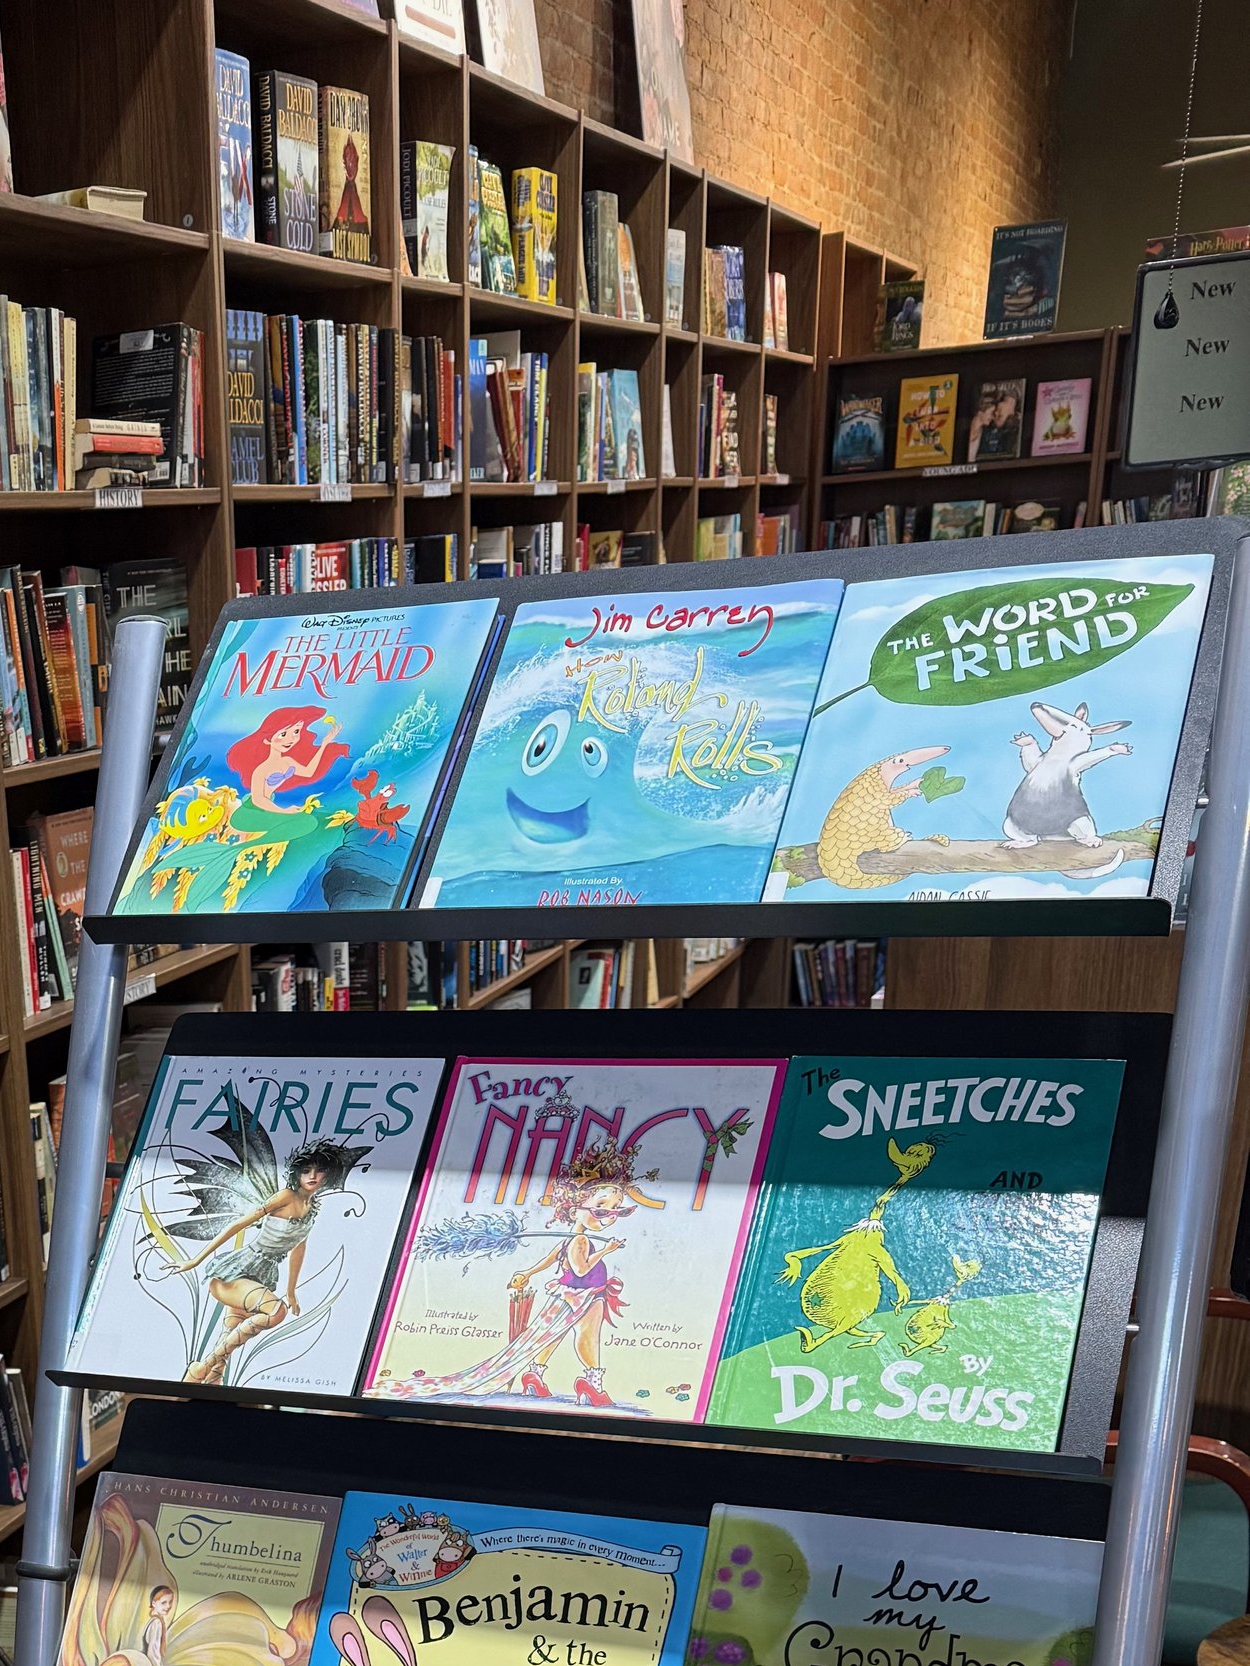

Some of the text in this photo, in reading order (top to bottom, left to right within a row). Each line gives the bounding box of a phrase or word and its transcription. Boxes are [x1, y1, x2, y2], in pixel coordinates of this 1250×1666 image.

[286, 84, 313, 113] DAVID
[284, 188, 316, 221] STONE
[288, 221, 313, 250] COLD
[1029, 224, 1063, 236] HOARDING
[1191, 280, 1236, 299] New
[1022, 317, 1052, 330] BOOKS
[1185, 339, 1229, 356] New
[1181, 395, 1225, 412] New
[99, 491, 138, 506] HISTORY
[565, 603, 774, 657] Jim Carrey
[888, 586, 1149, 655] THE WORD FOR
[285, 626, 412, 652] THE LITTLE
[223, 645, 435, 698] MERMAID
[579, 646, 726, 733] Roland
[668, 701, 782, 789] Rolls
[468, 1071, 573, 1105] Fancy
[802, 1066, 841, 1097] The
[165, 1079, 419, 1137] FAIRIES
[818, 1077, 1084, 1139] SNEETCHES
[464, 1105, 749, 1212] NANCY
[990, 1171, 1042, 1189] AND
[394, 1321, 503, 1340] Robin Preiss Glasser
[605, 1335, 702, 1351] Jane O'Connor
[959, 1354, 993, 1376] By
[771, 1361, 1034, 1431] Dr. Seuss
[114, 1481, 329, 1515] HANS CHRISTIAN ANDERSEN
[166, 1514, 302, 1562] Thumbelina
[832, 1560, 989, 1604] I love
[413, 1574, 649, 1645] Benjamin
[863, 1607, 946, 1651] my
[528, 1635, 607, 1666] & the
